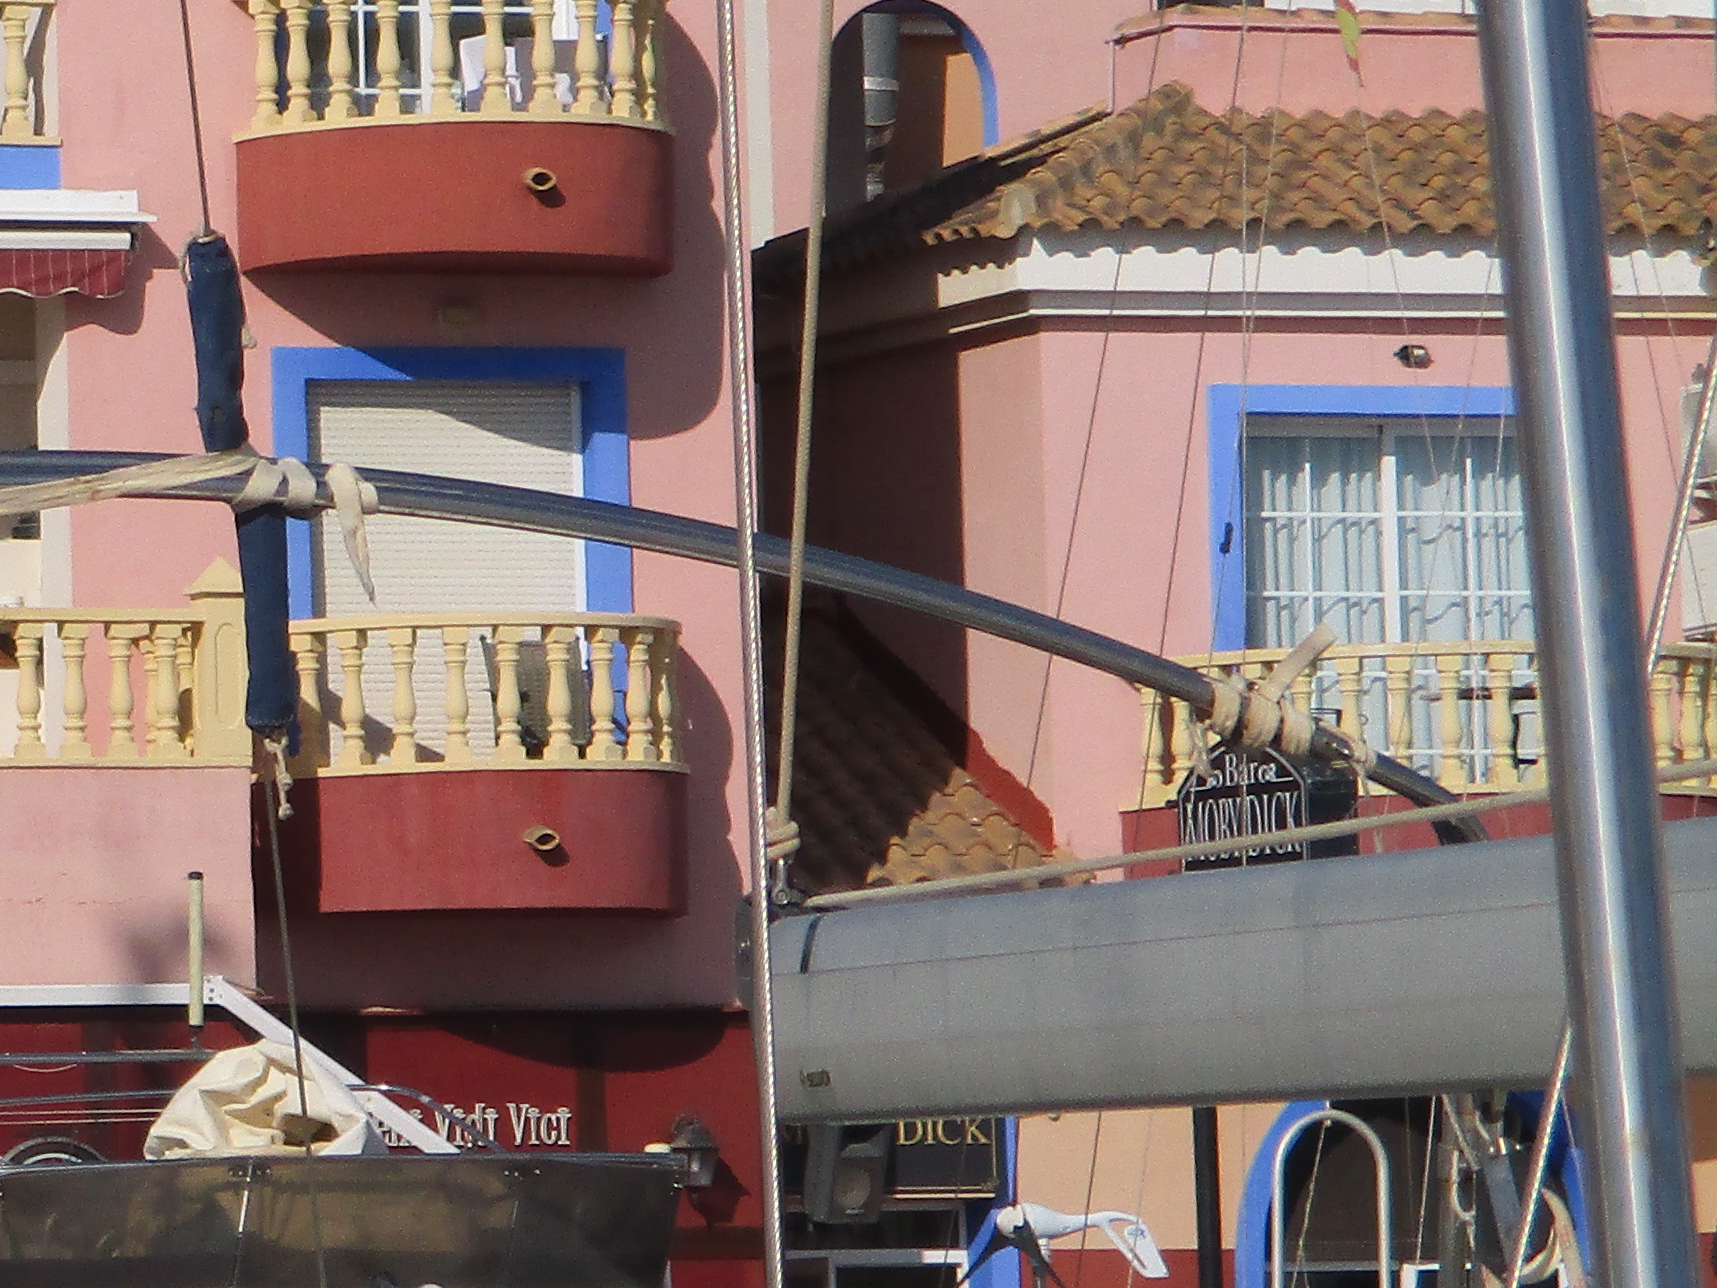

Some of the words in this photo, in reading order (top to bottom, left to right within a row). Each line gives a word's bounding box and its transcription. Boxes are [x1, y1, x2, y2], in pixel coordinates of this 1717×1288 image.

[1246, 791, 1302, 856] DICK
[506, 1103, 572, 1146] Vici
[896, 1116, 991, 1146] DICK
